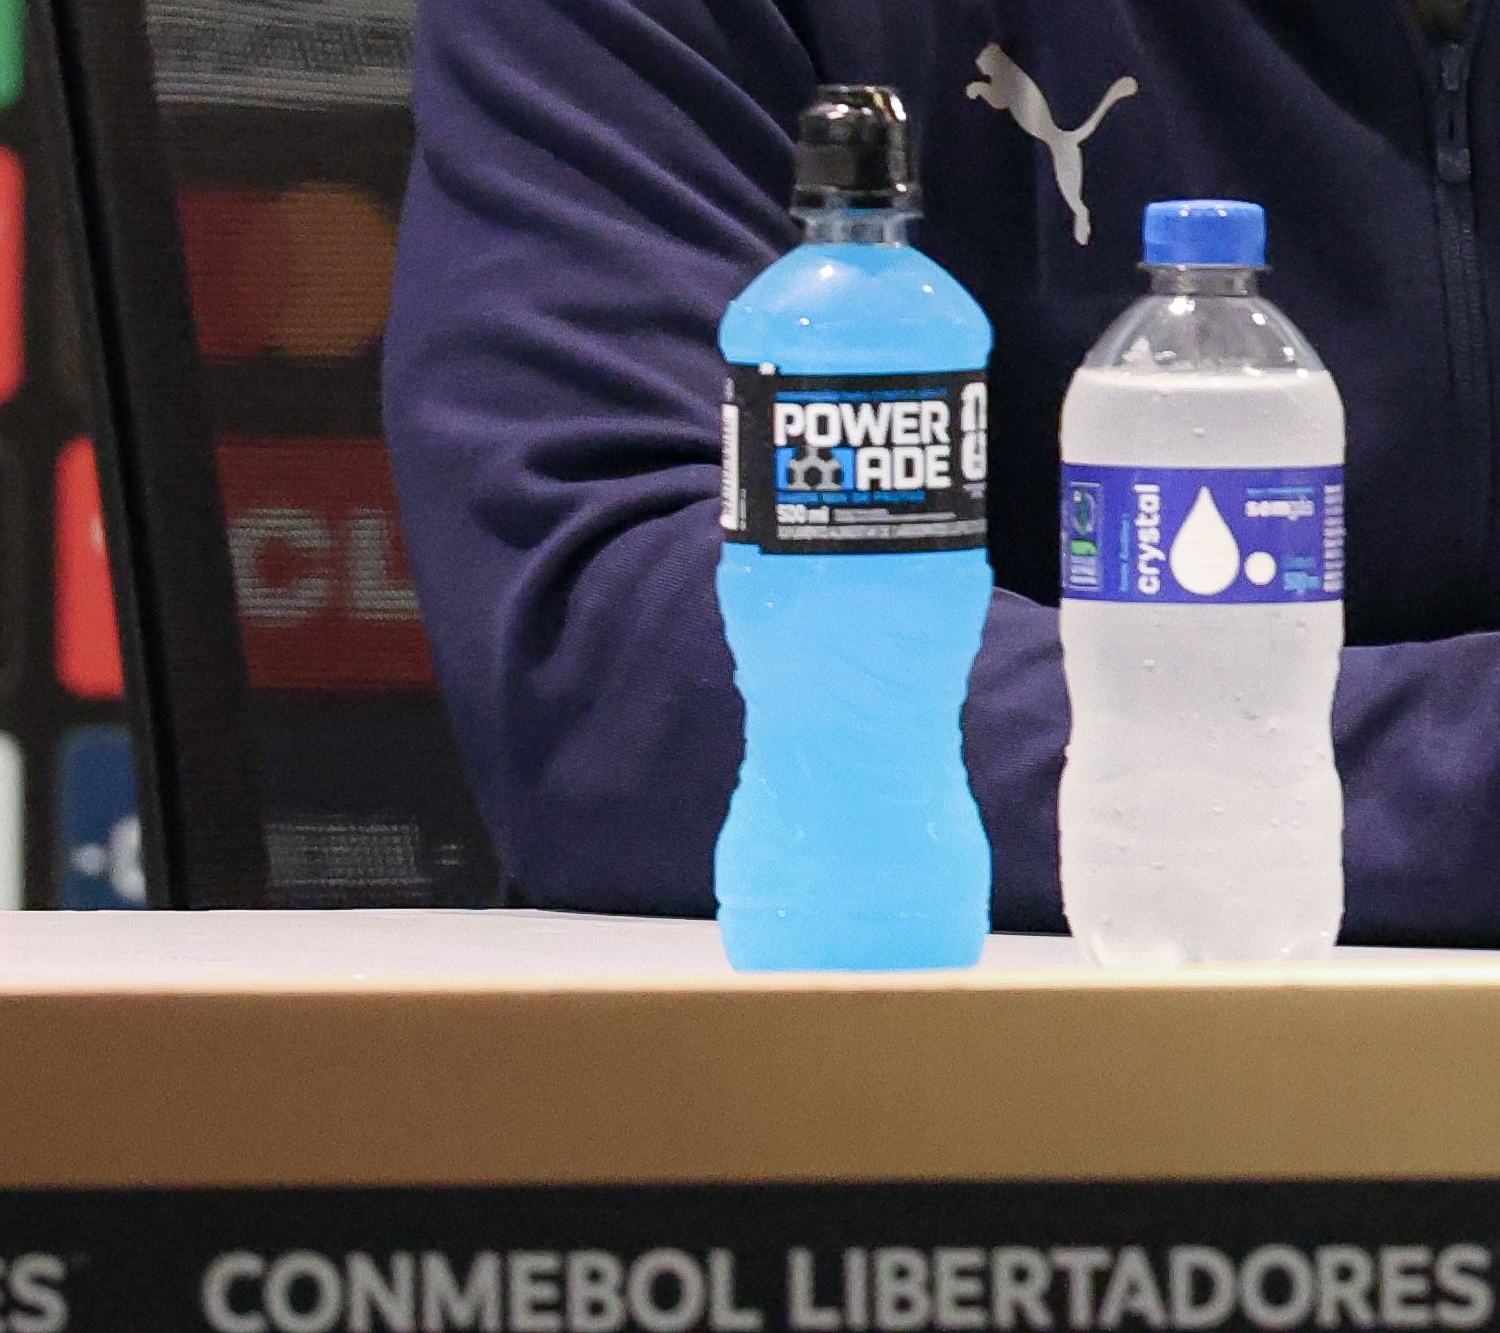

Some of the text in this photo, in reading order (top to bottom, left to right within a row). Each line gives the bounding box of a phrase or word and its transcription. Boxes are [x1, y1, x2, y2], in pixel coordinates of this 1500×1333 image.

[773, 400, 950, 447] POWER
[1133, 483, 1167, 595] crystal
[202, 1243, 1494, 1333] CONMEBOL LIBERTADORES
